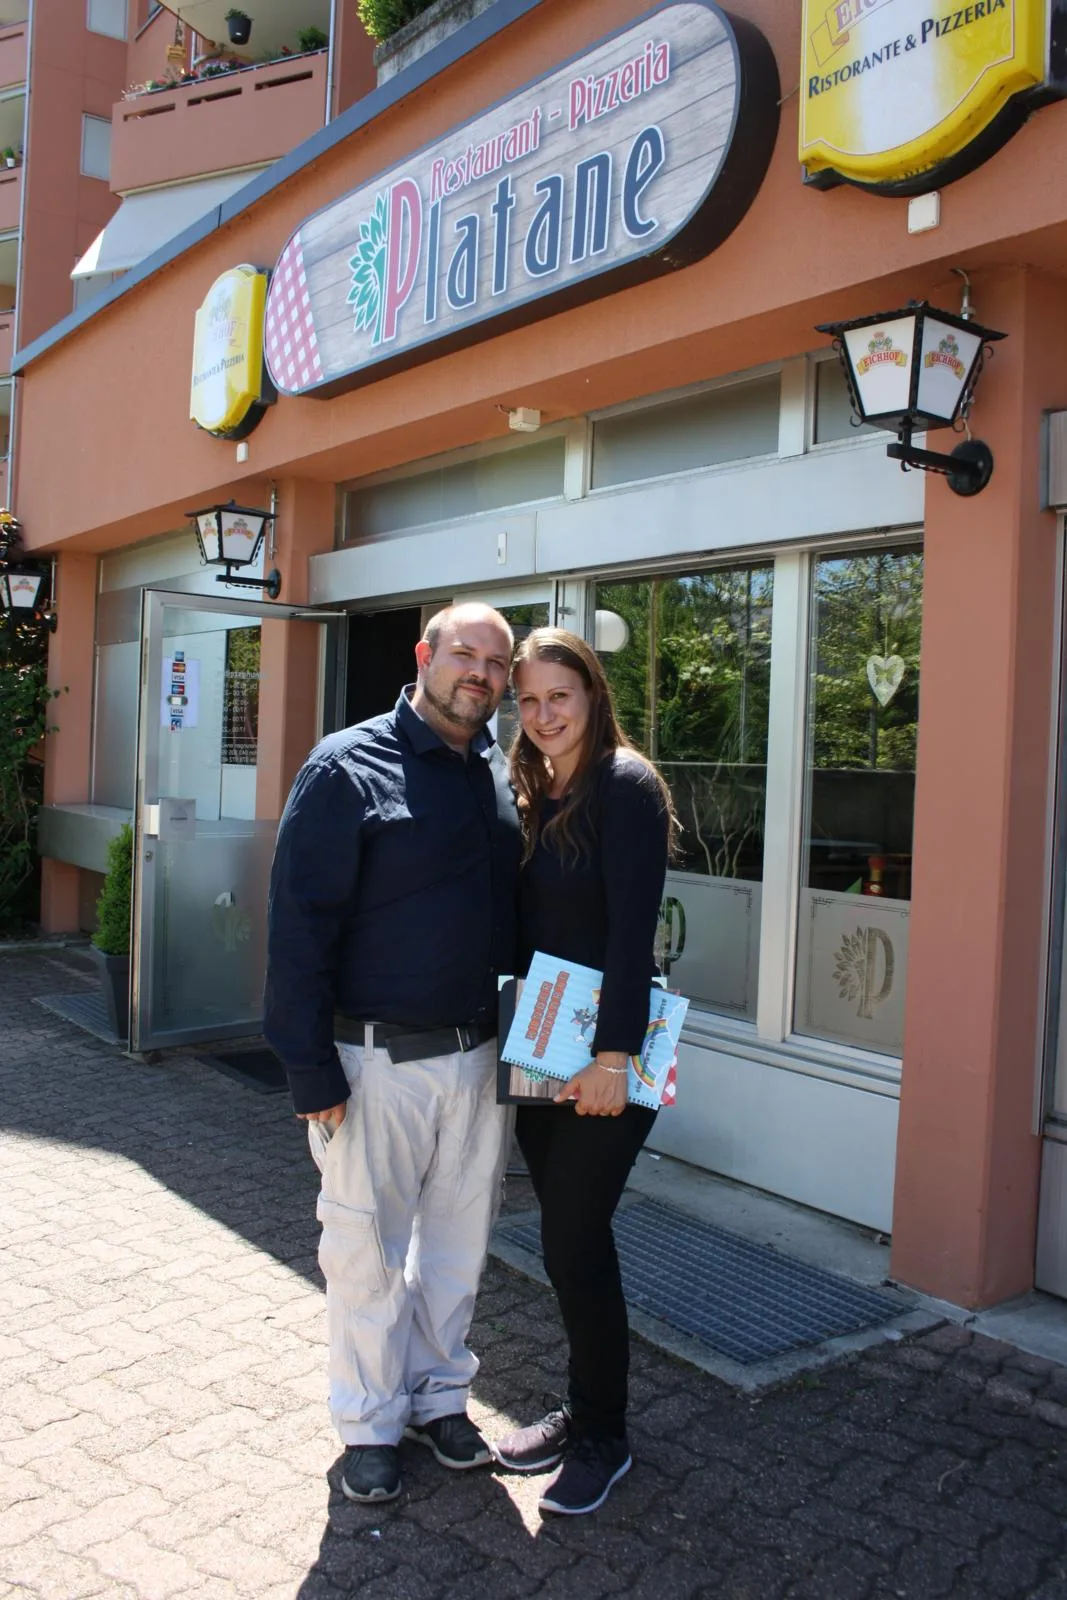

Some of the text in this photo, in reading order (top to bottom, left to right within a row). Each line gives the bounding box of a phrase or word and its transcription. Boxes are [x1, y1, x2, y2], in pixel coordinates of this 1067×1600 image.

[432, 110, 540, 198] Restaurant
[570, 43, 669, 130] Pizzeria
[808, 40, 901, 98] RISTORANTE
[904, 34, 918, 52] &
[384, 126, 665, 341] Platane
